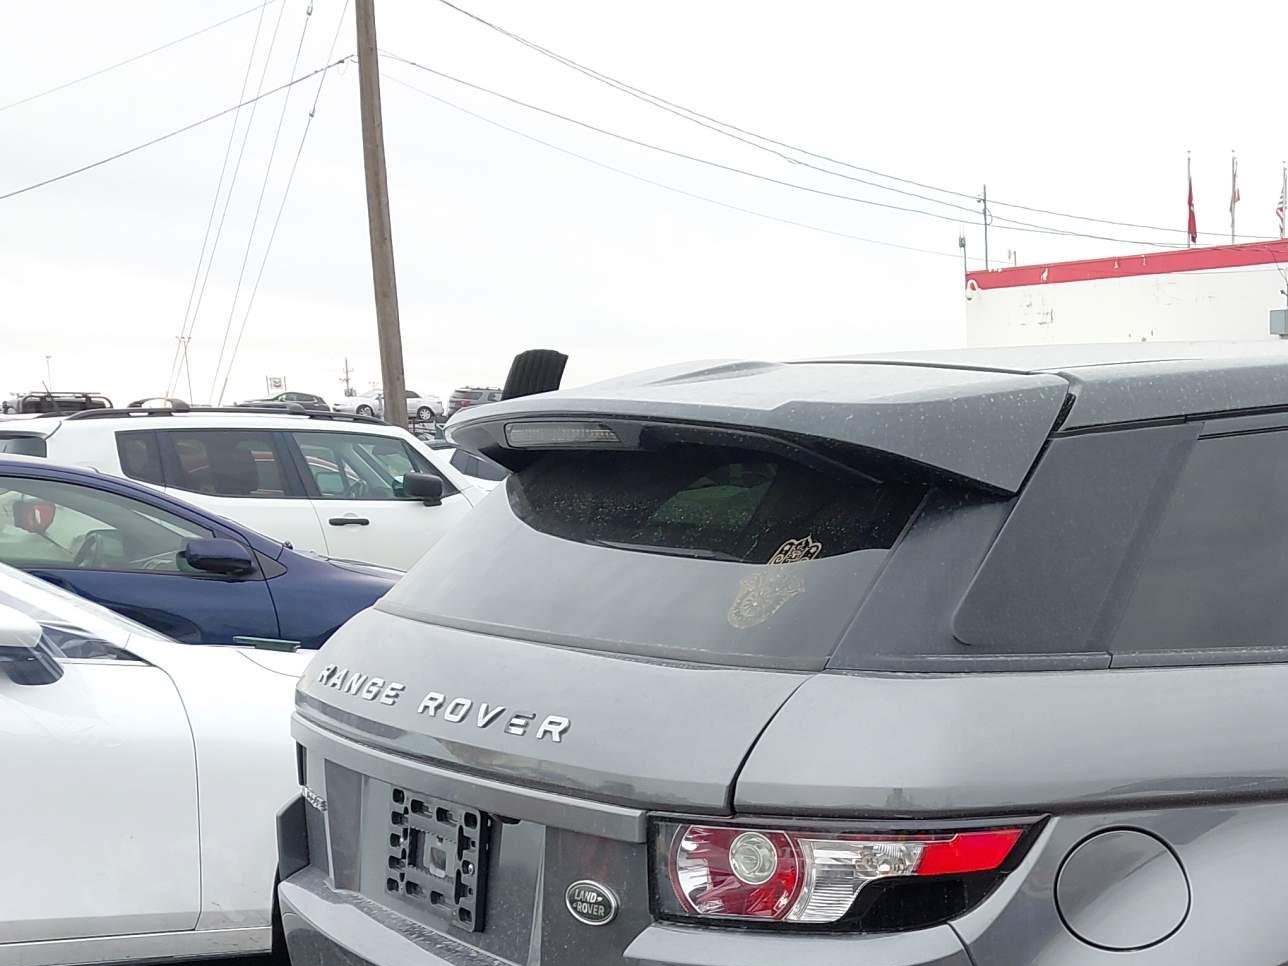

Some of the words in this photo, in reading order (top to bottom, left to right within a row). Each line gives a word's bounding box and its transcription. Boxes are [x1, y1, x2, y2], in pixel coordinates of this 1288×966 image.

[318, 663, 406, 706] RANGE
[417, 691, 572, 744] ROVER
[574, 888, 598, 904] LAND
[576, 901, 605, 917] ROVER
